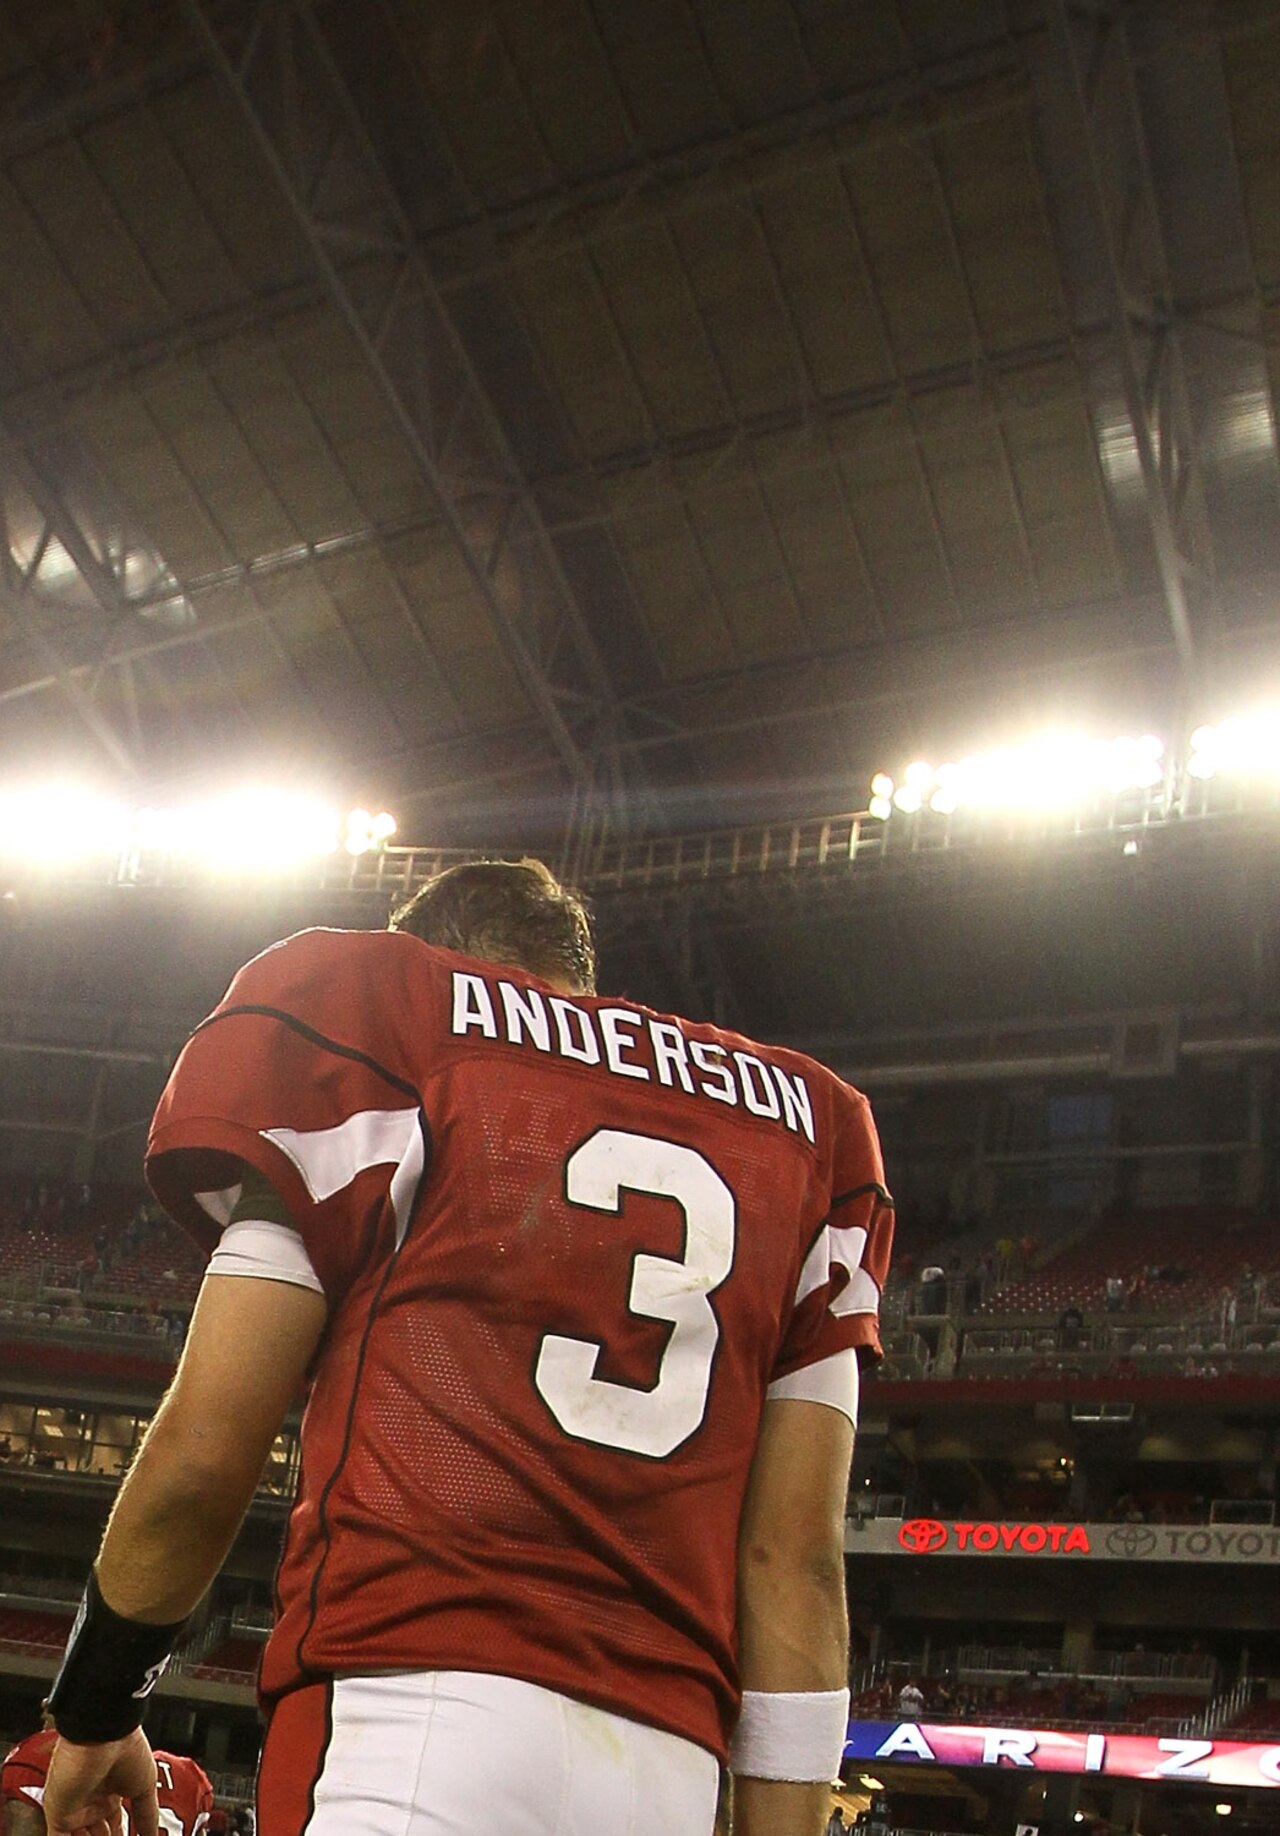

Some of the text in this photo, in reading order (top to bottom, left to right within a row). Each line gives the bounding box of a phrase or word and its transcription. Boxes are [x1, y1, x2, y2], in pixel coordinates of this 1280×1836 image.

[452, 972, 816, 1144] ANDERSON
[535, 1128, 736, 1459] 3
[954, 1522, 1090, 1553] TOYOTA
